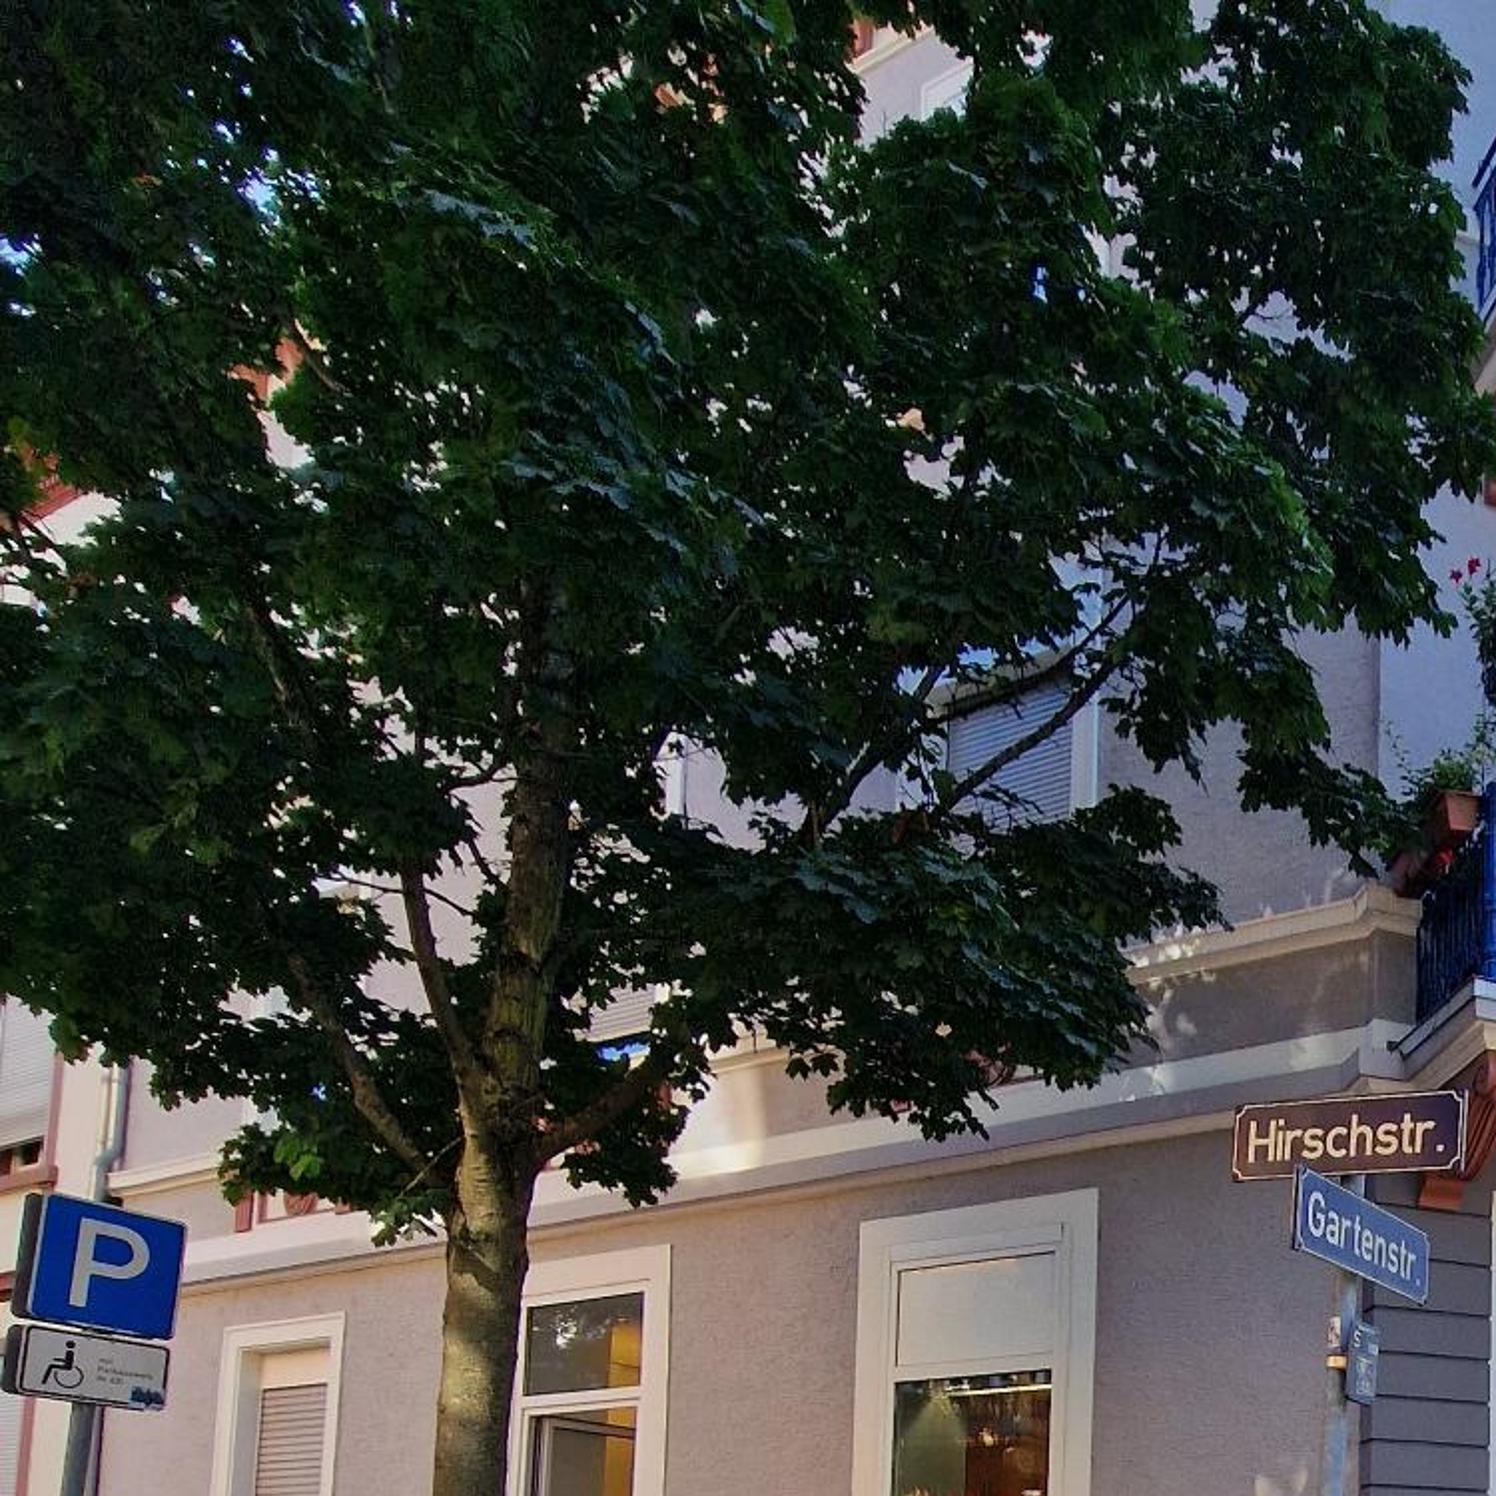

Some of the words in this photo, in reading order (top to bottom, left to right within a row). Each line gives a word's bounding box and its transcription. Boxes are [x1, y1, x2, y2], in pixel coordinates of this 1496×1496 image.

[1247, 1111, 1445, 1164] Hirschstr.
[69, 1216, 150, 1308] P
[1307, 1190, 1421, 1287] Gartenstr.
